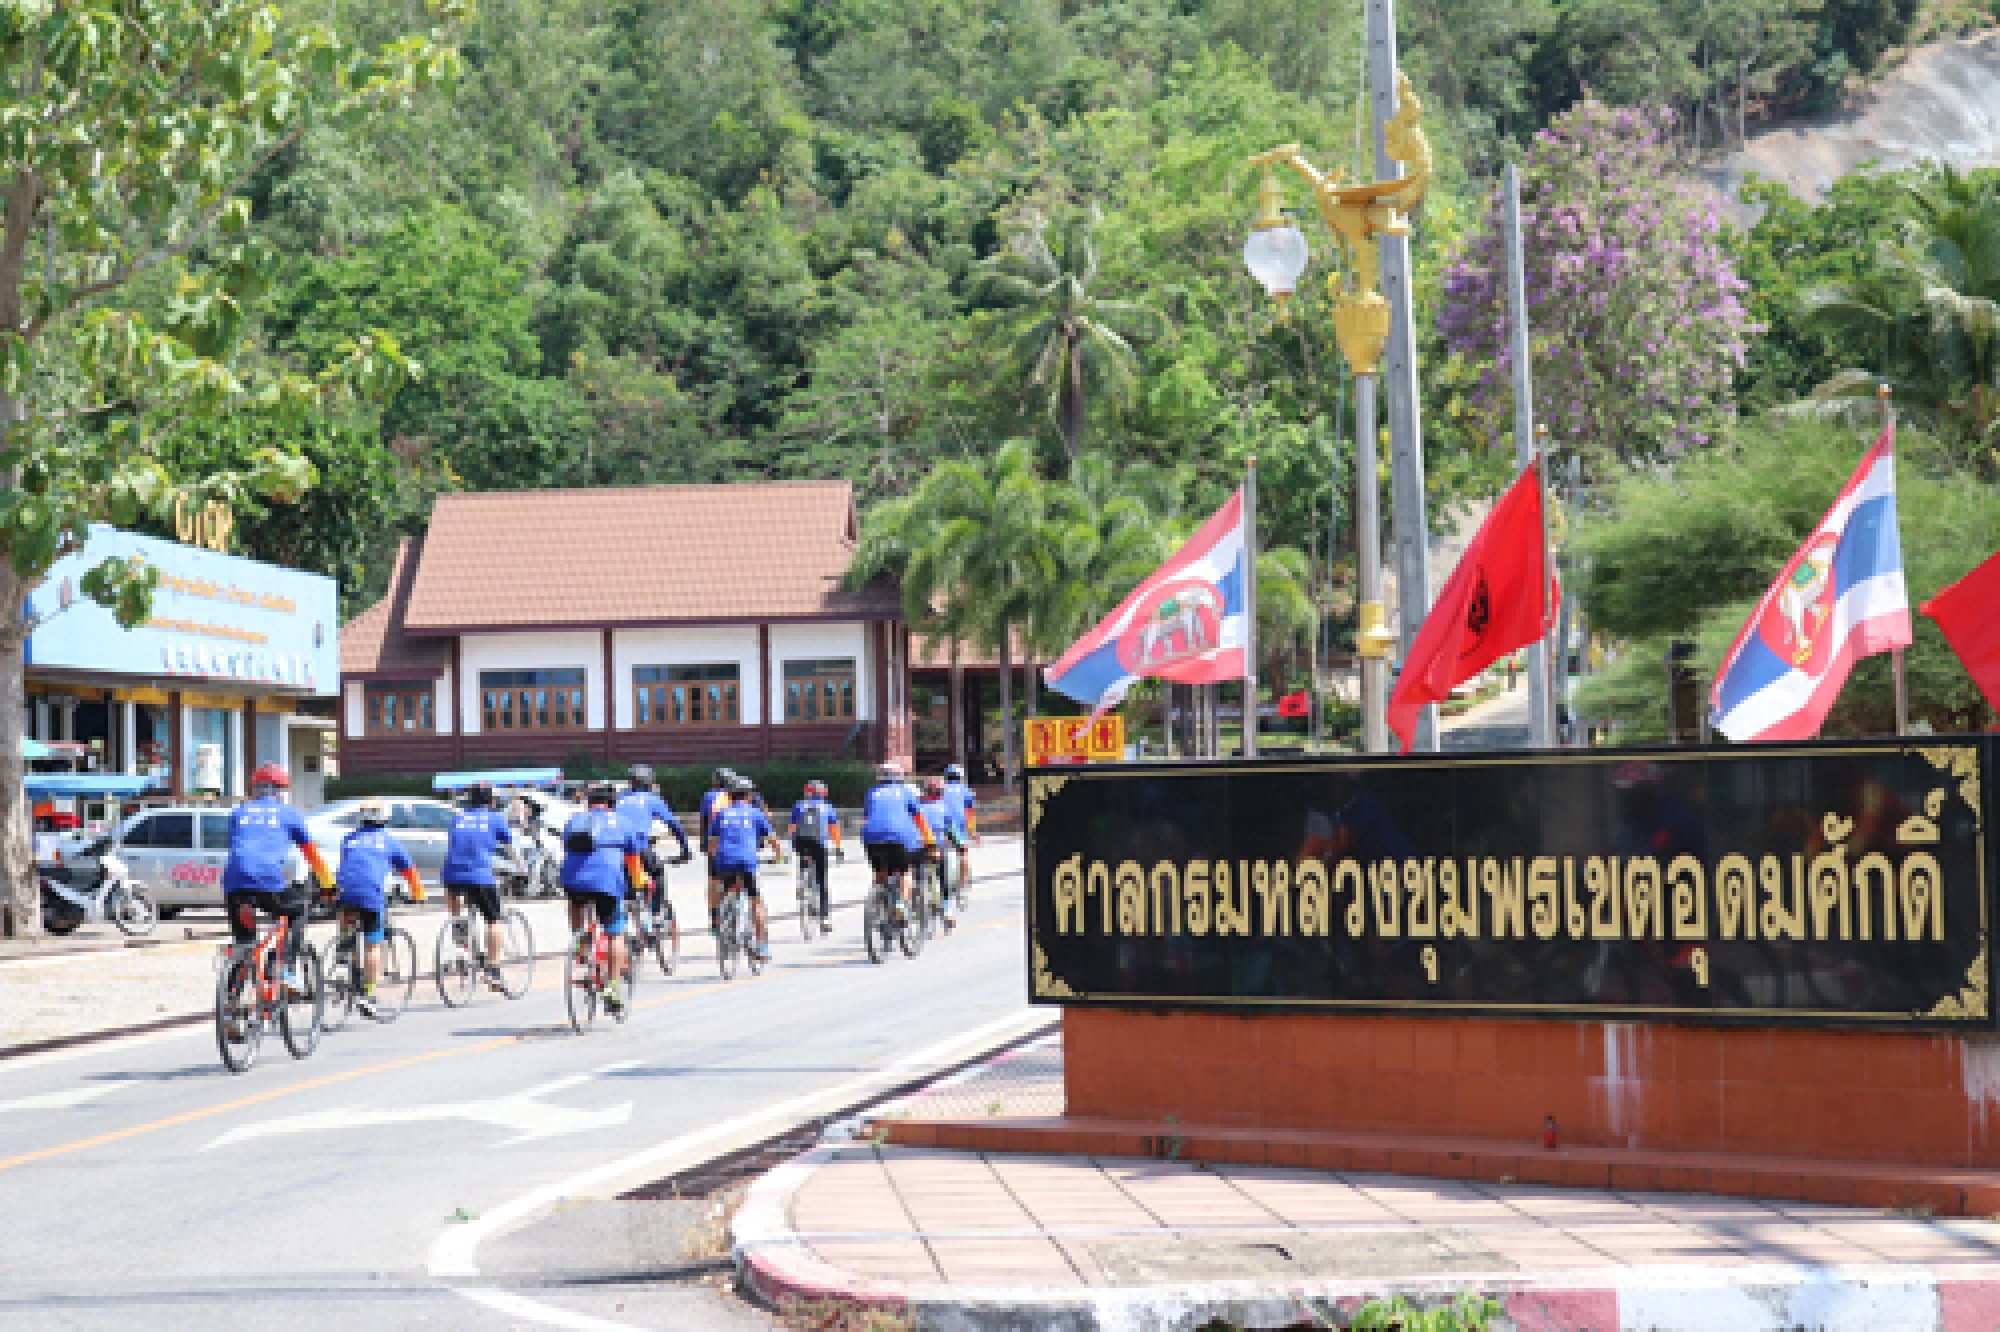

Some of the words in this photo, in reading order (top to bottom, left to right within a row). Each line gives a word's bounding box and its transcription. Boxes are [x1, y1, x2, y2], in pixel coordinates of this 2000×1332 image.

[1052, 787, 1945, 988] ศาลกรมหลวงชุมพรเขตอุดมศักดิ์
